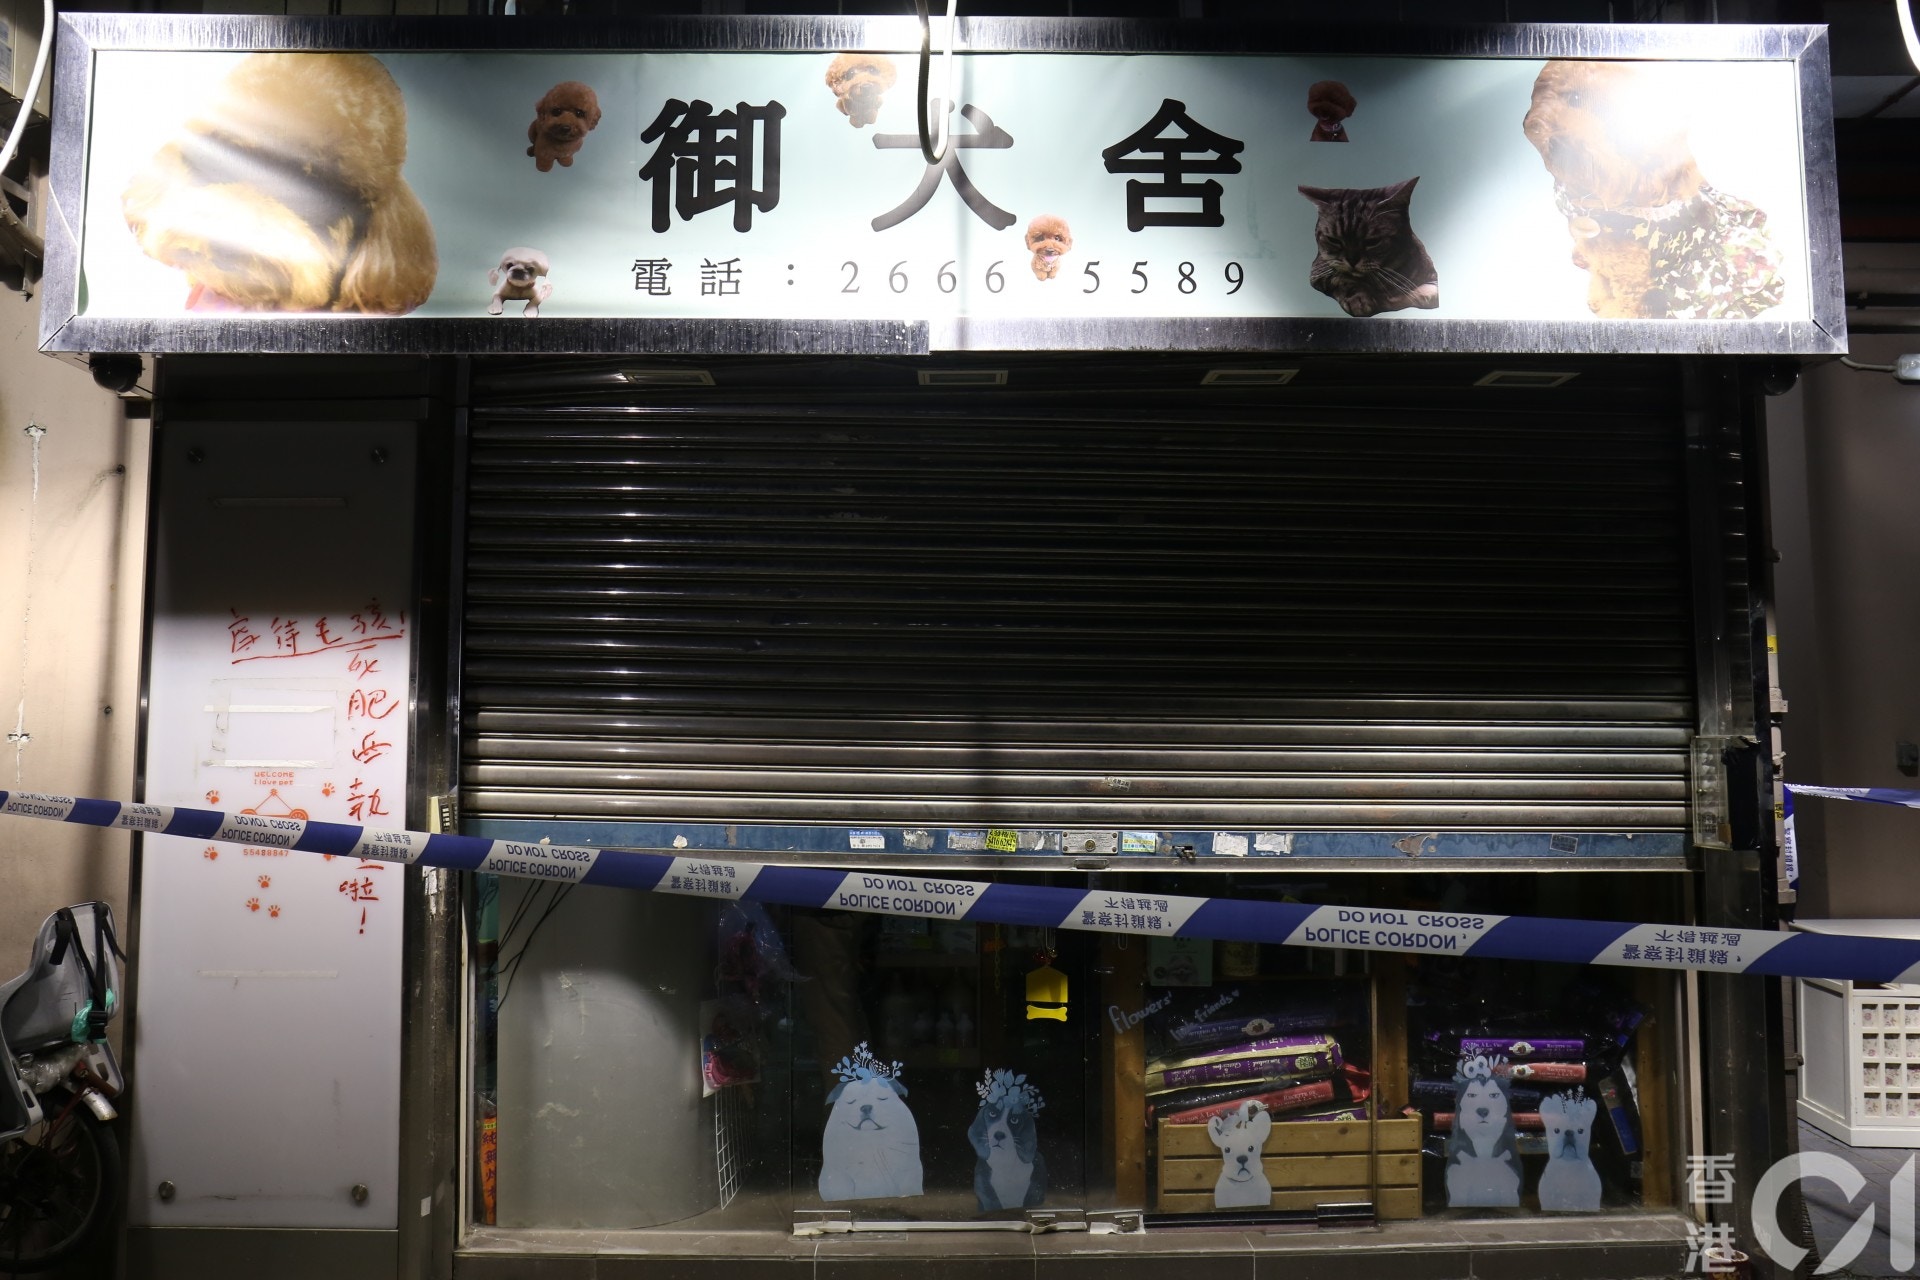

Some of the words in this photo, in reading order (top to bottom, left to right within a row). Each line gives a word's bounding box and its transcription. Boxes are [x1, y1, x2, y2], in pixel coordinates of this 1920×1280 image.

[639, 98, 1245, 233] 御犬舍
[840, 260, 1006, 294] 2666
[1082, 260, 1245, 295] 5589
